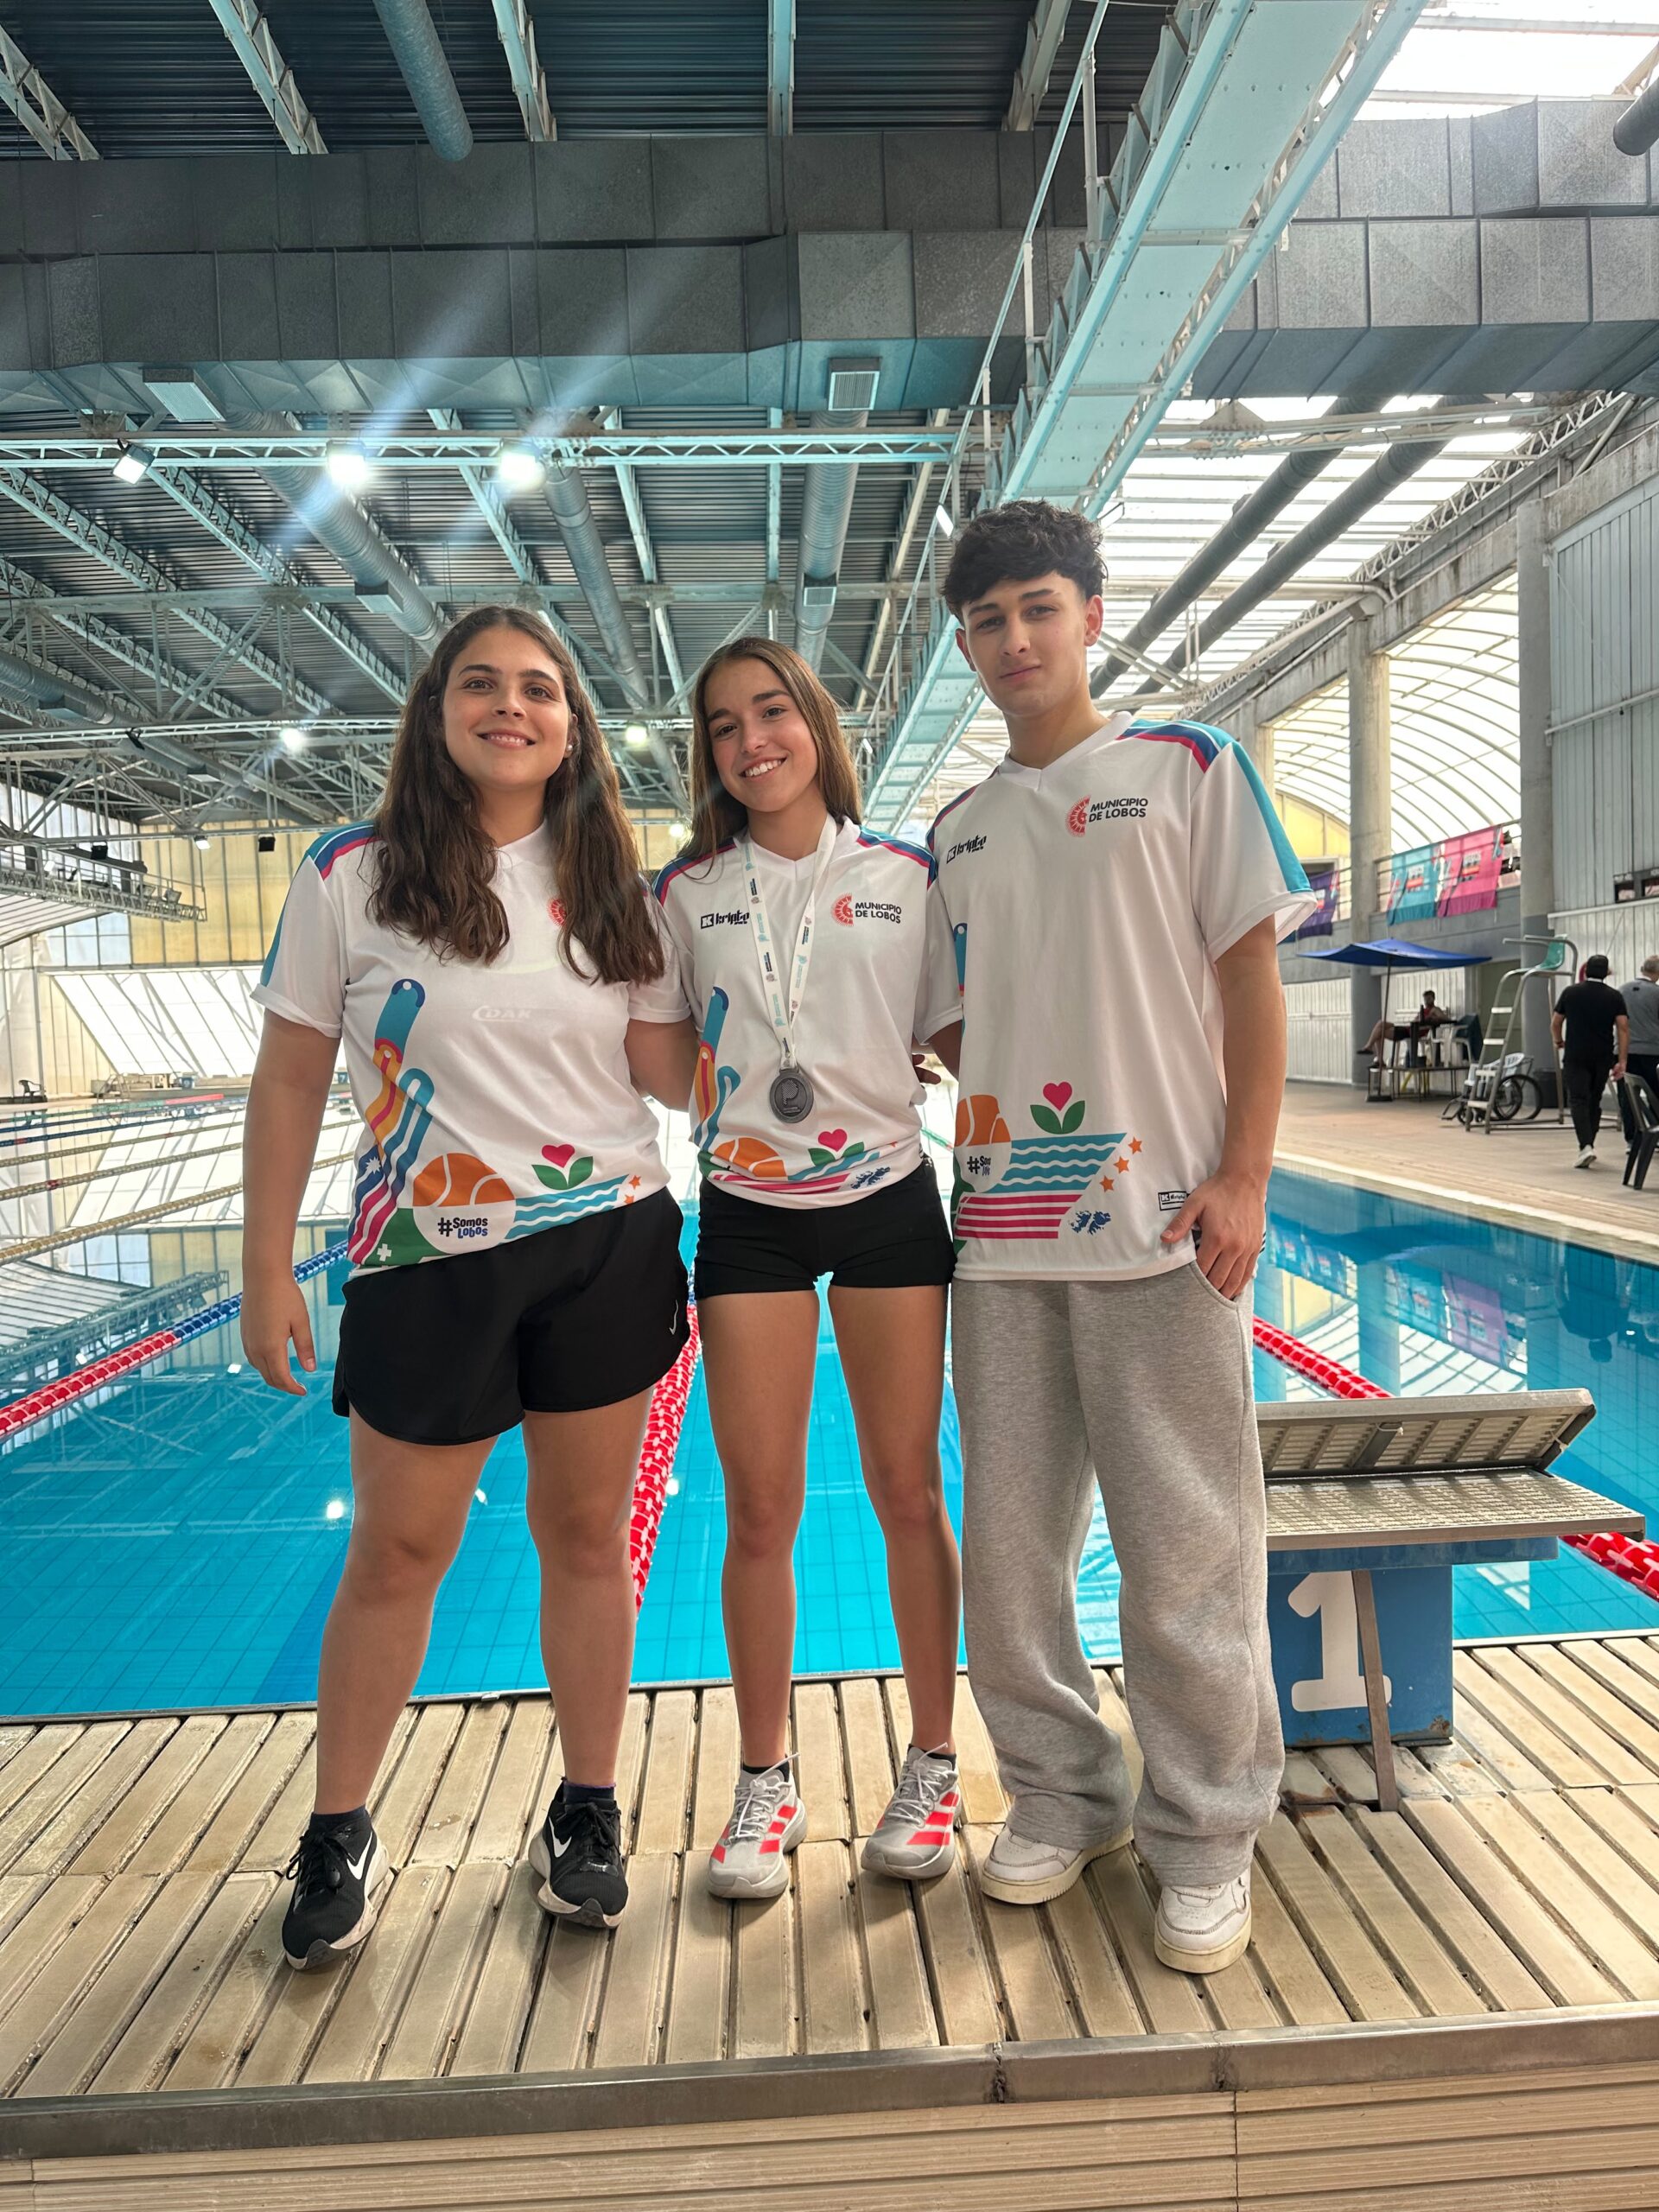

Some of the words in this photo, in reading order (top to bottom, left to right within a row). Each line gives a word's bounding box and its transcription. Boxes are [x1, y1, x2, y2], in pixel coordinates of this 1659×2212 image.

[1090, 798, 1148, 812] MUNICIPIO
[1089, 811, 1103, 823] DE
[1105, 807, 1147, 818] LOBOS
[855, 902, 902, 915] MUNICIPIO
[870, 910, 901, 924] LOBOS
[437, 1217, 488, 1237] #Somos
[457, 1227, 488, 1239] Lobos
[1287, 1571, 1392, 1713] 1
